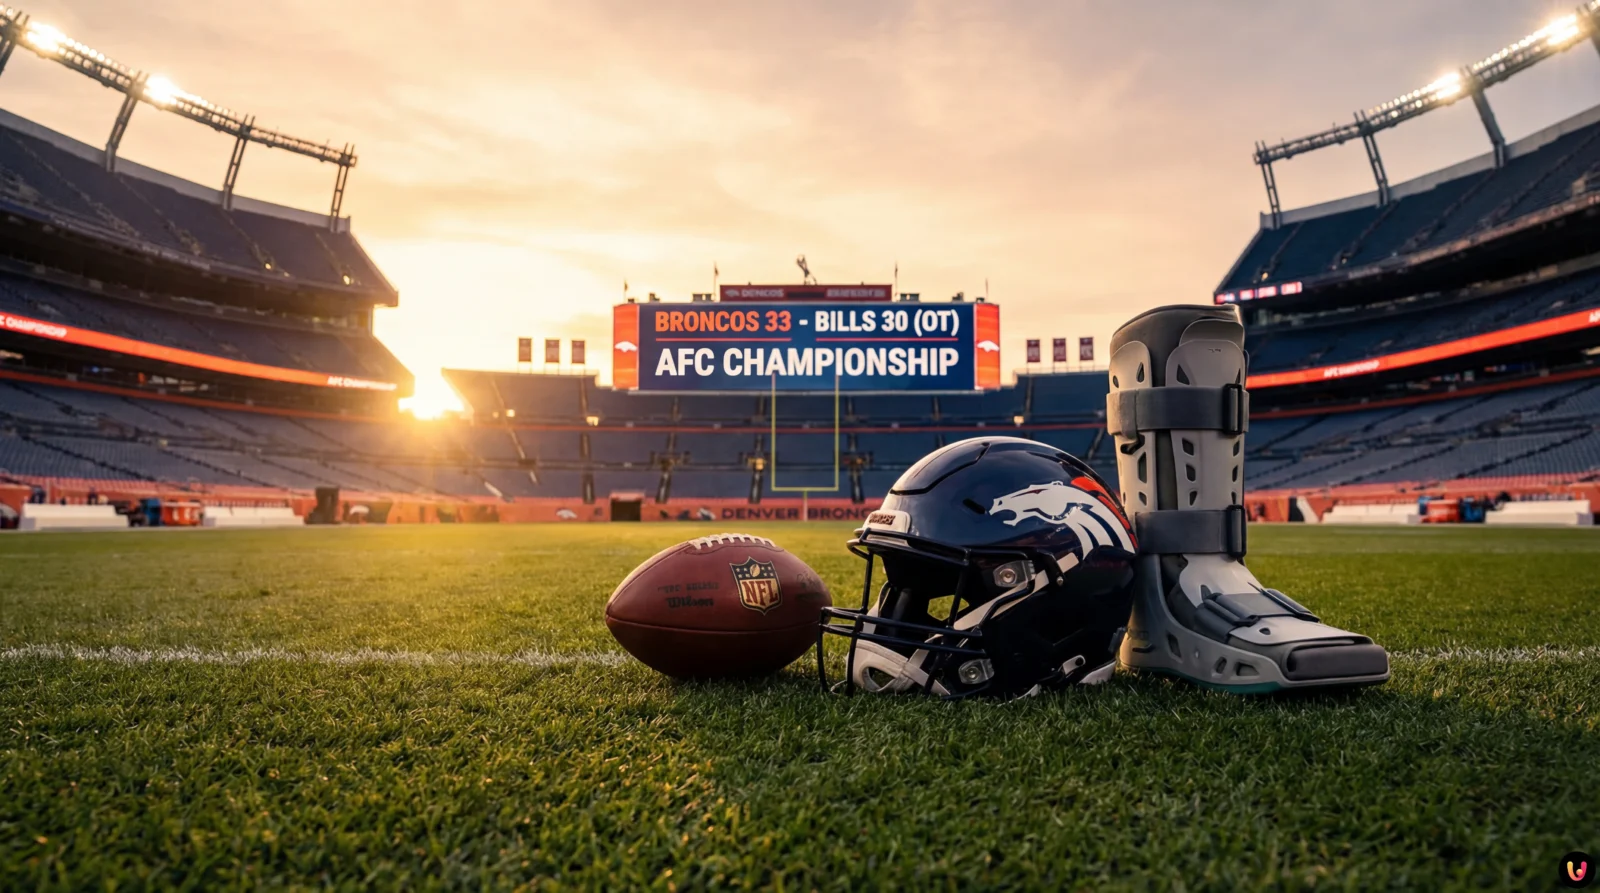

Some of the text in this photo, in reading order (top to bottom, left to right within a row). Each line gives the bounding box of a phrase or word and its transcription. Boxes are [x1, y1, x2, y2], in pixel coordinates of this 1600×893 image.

[655, 310, 760, 333] BRONCOS
[764, 310, 792, 333] 33
[815, 310, 877, 333] BILLS
[881, 310, 909, 333] 30
[913, 309, 960, 337] (OT)
[654, 347, 959, 377] AFC CHAMPIONSHIP
[722, 507, 799, 520] DENVER
[808, 507, 877, 520] BRONC
[665, 595, 714, 609] Wilson
[742, 580, 778, 607] NFL
